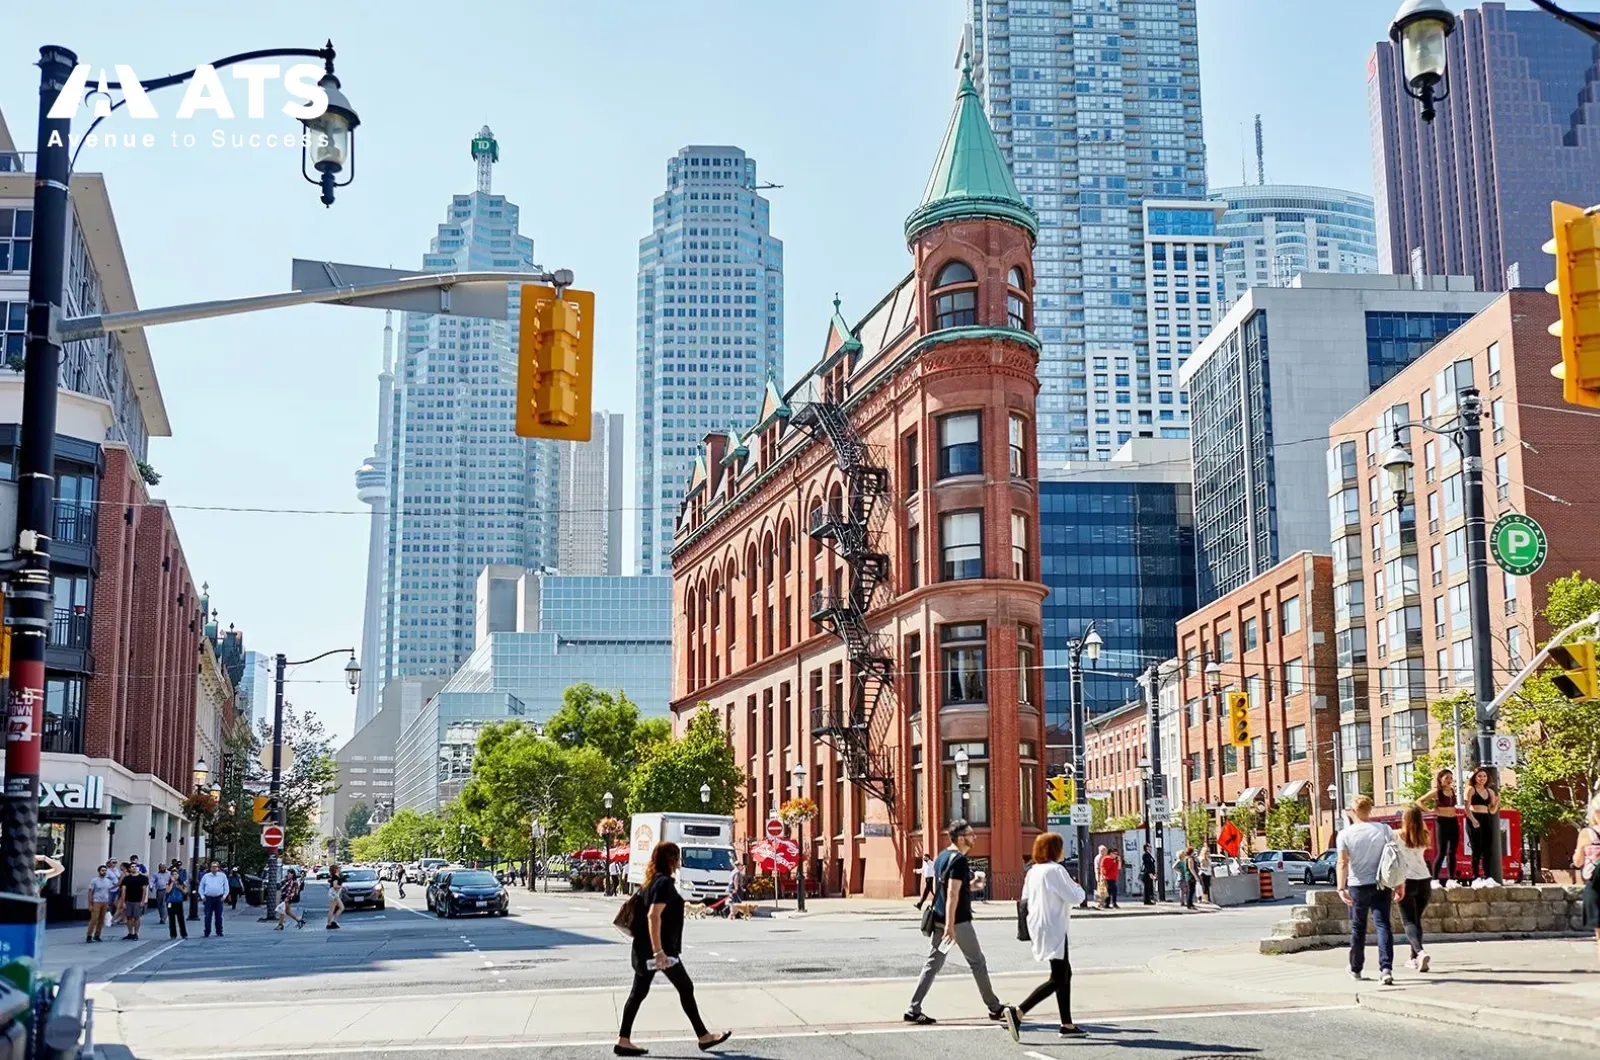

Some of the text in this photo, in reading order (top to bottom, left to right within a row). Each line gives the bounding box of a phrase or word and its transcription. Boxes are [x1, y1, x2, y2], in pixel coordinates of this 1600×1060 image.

[476, 140, 490, 150] TD
[1491, 516, 1543, 543] MUNICIPAL
[1507, 529, 1531, 554] P
[1492, 549, 1544, 574] PARKING
[38, 775, 104, 809] xall
